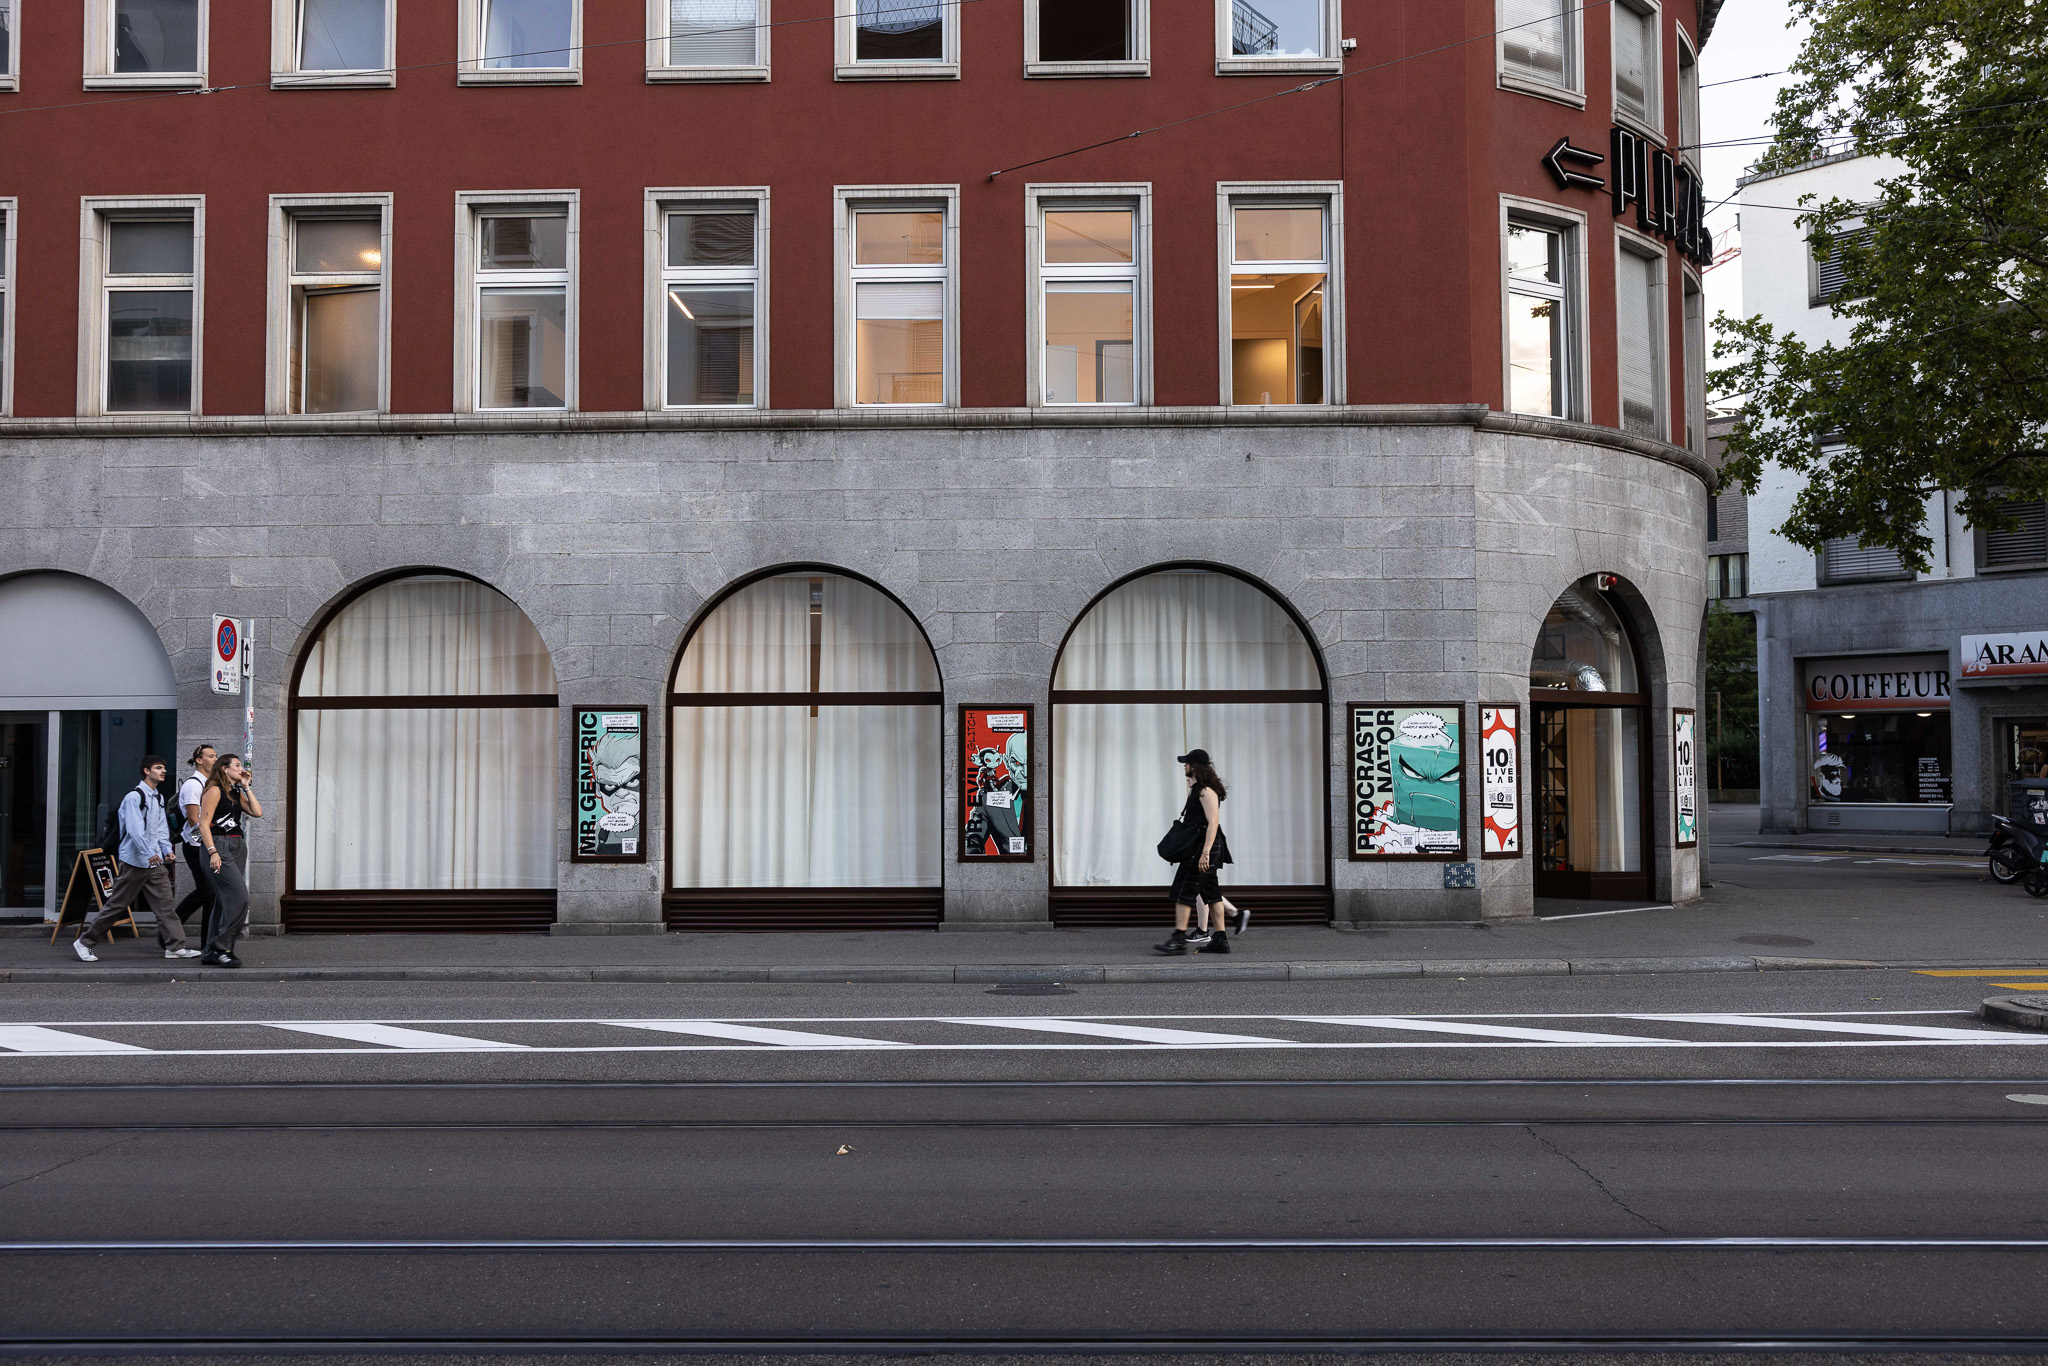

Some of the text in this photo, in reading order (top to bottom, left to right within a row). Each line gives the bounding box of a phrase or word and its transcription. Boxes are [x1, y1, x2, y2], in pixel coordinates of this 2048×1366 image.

[1811, 670, 1950, 701] COIFFEUR
[967, 712, 976, 751] GLITCH
[1376, 710, 1394, 792] NATOR
[1486, 748, 1508, 767] 10
[1678, 741, 1690, 765] 10
[580, 713, 597, 854] MR. GENERIC
[1356, 710, 1375, 850] PROCRASTI
[1678, 767, 1692, 775] LIVE
[1678, 777, 1692, 786] LAB
